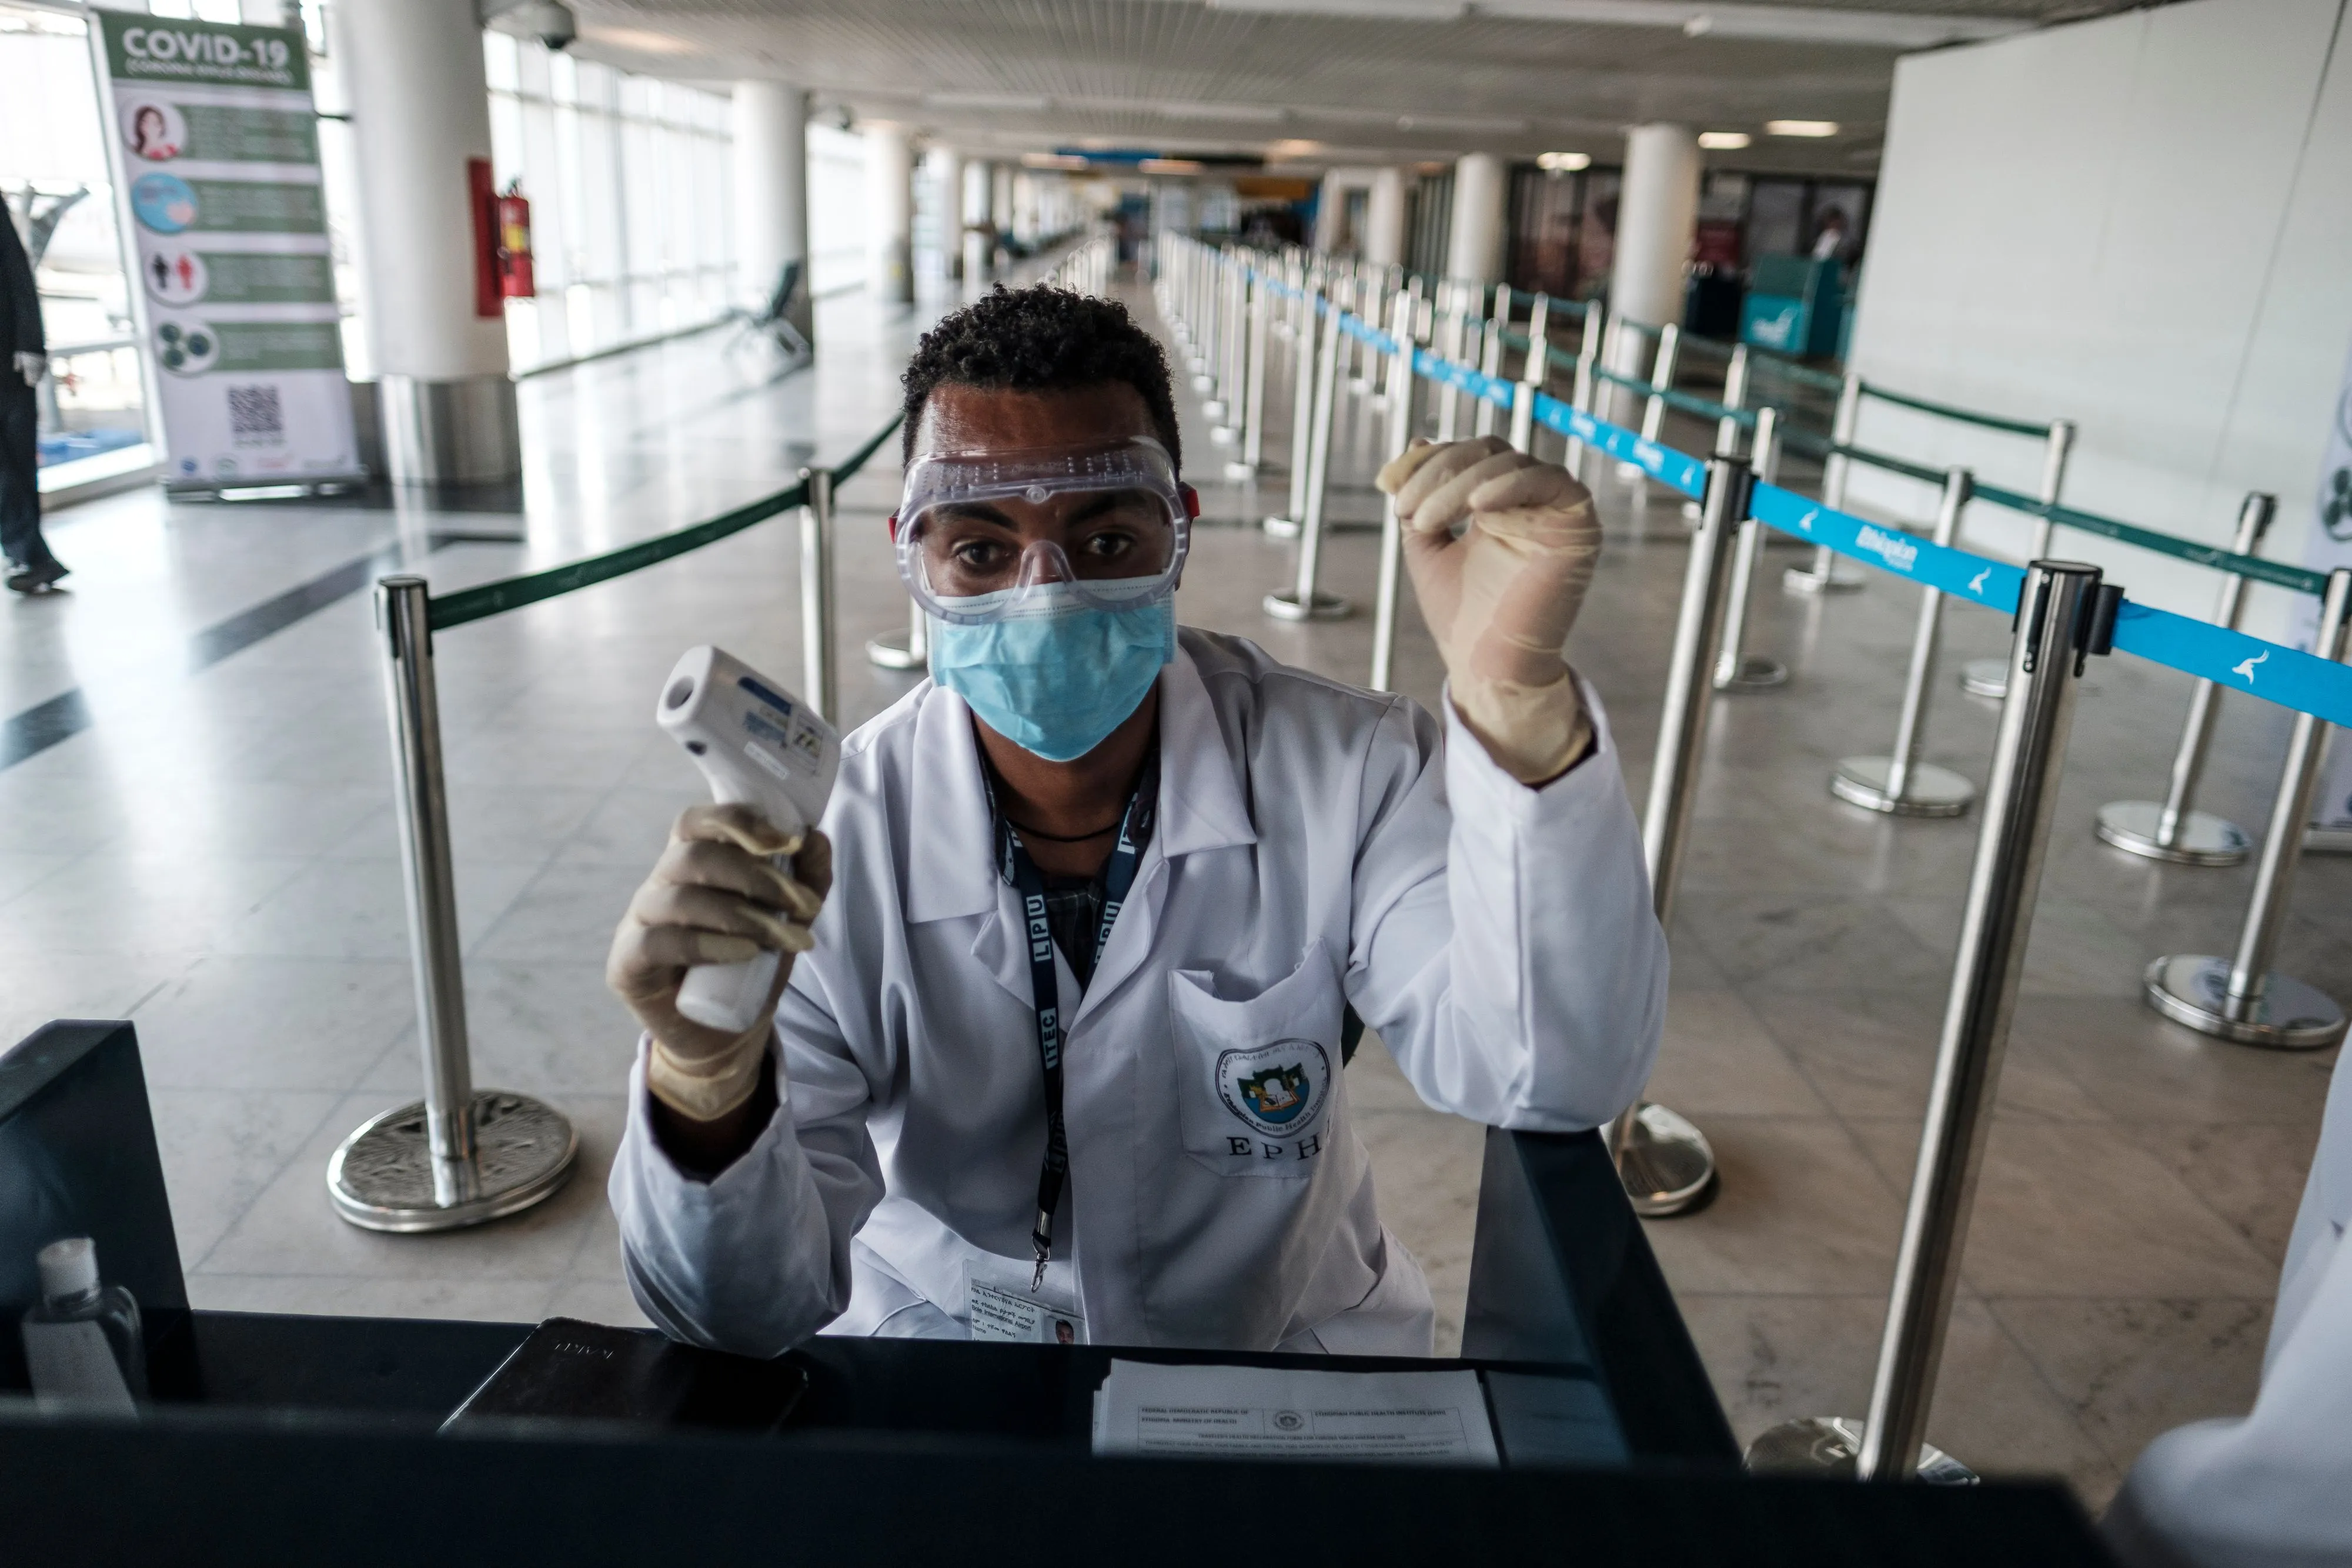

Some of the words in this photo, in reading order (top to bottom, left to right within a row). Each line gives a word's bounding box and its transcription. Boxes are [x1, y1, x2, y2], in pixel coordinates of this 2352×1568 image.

[122, 26, 289, 69] COVID-19
[1027, 897, 1051, 959] LPU
[1040, 1009, 1058, 1068] ITEC
[971, 1305, 983, 1313] Bole
[984, 1309, 1013, 1324] International
[1014, 1320, 1032, 1332] Airport
[973, 1325, 987, 1334] Name
